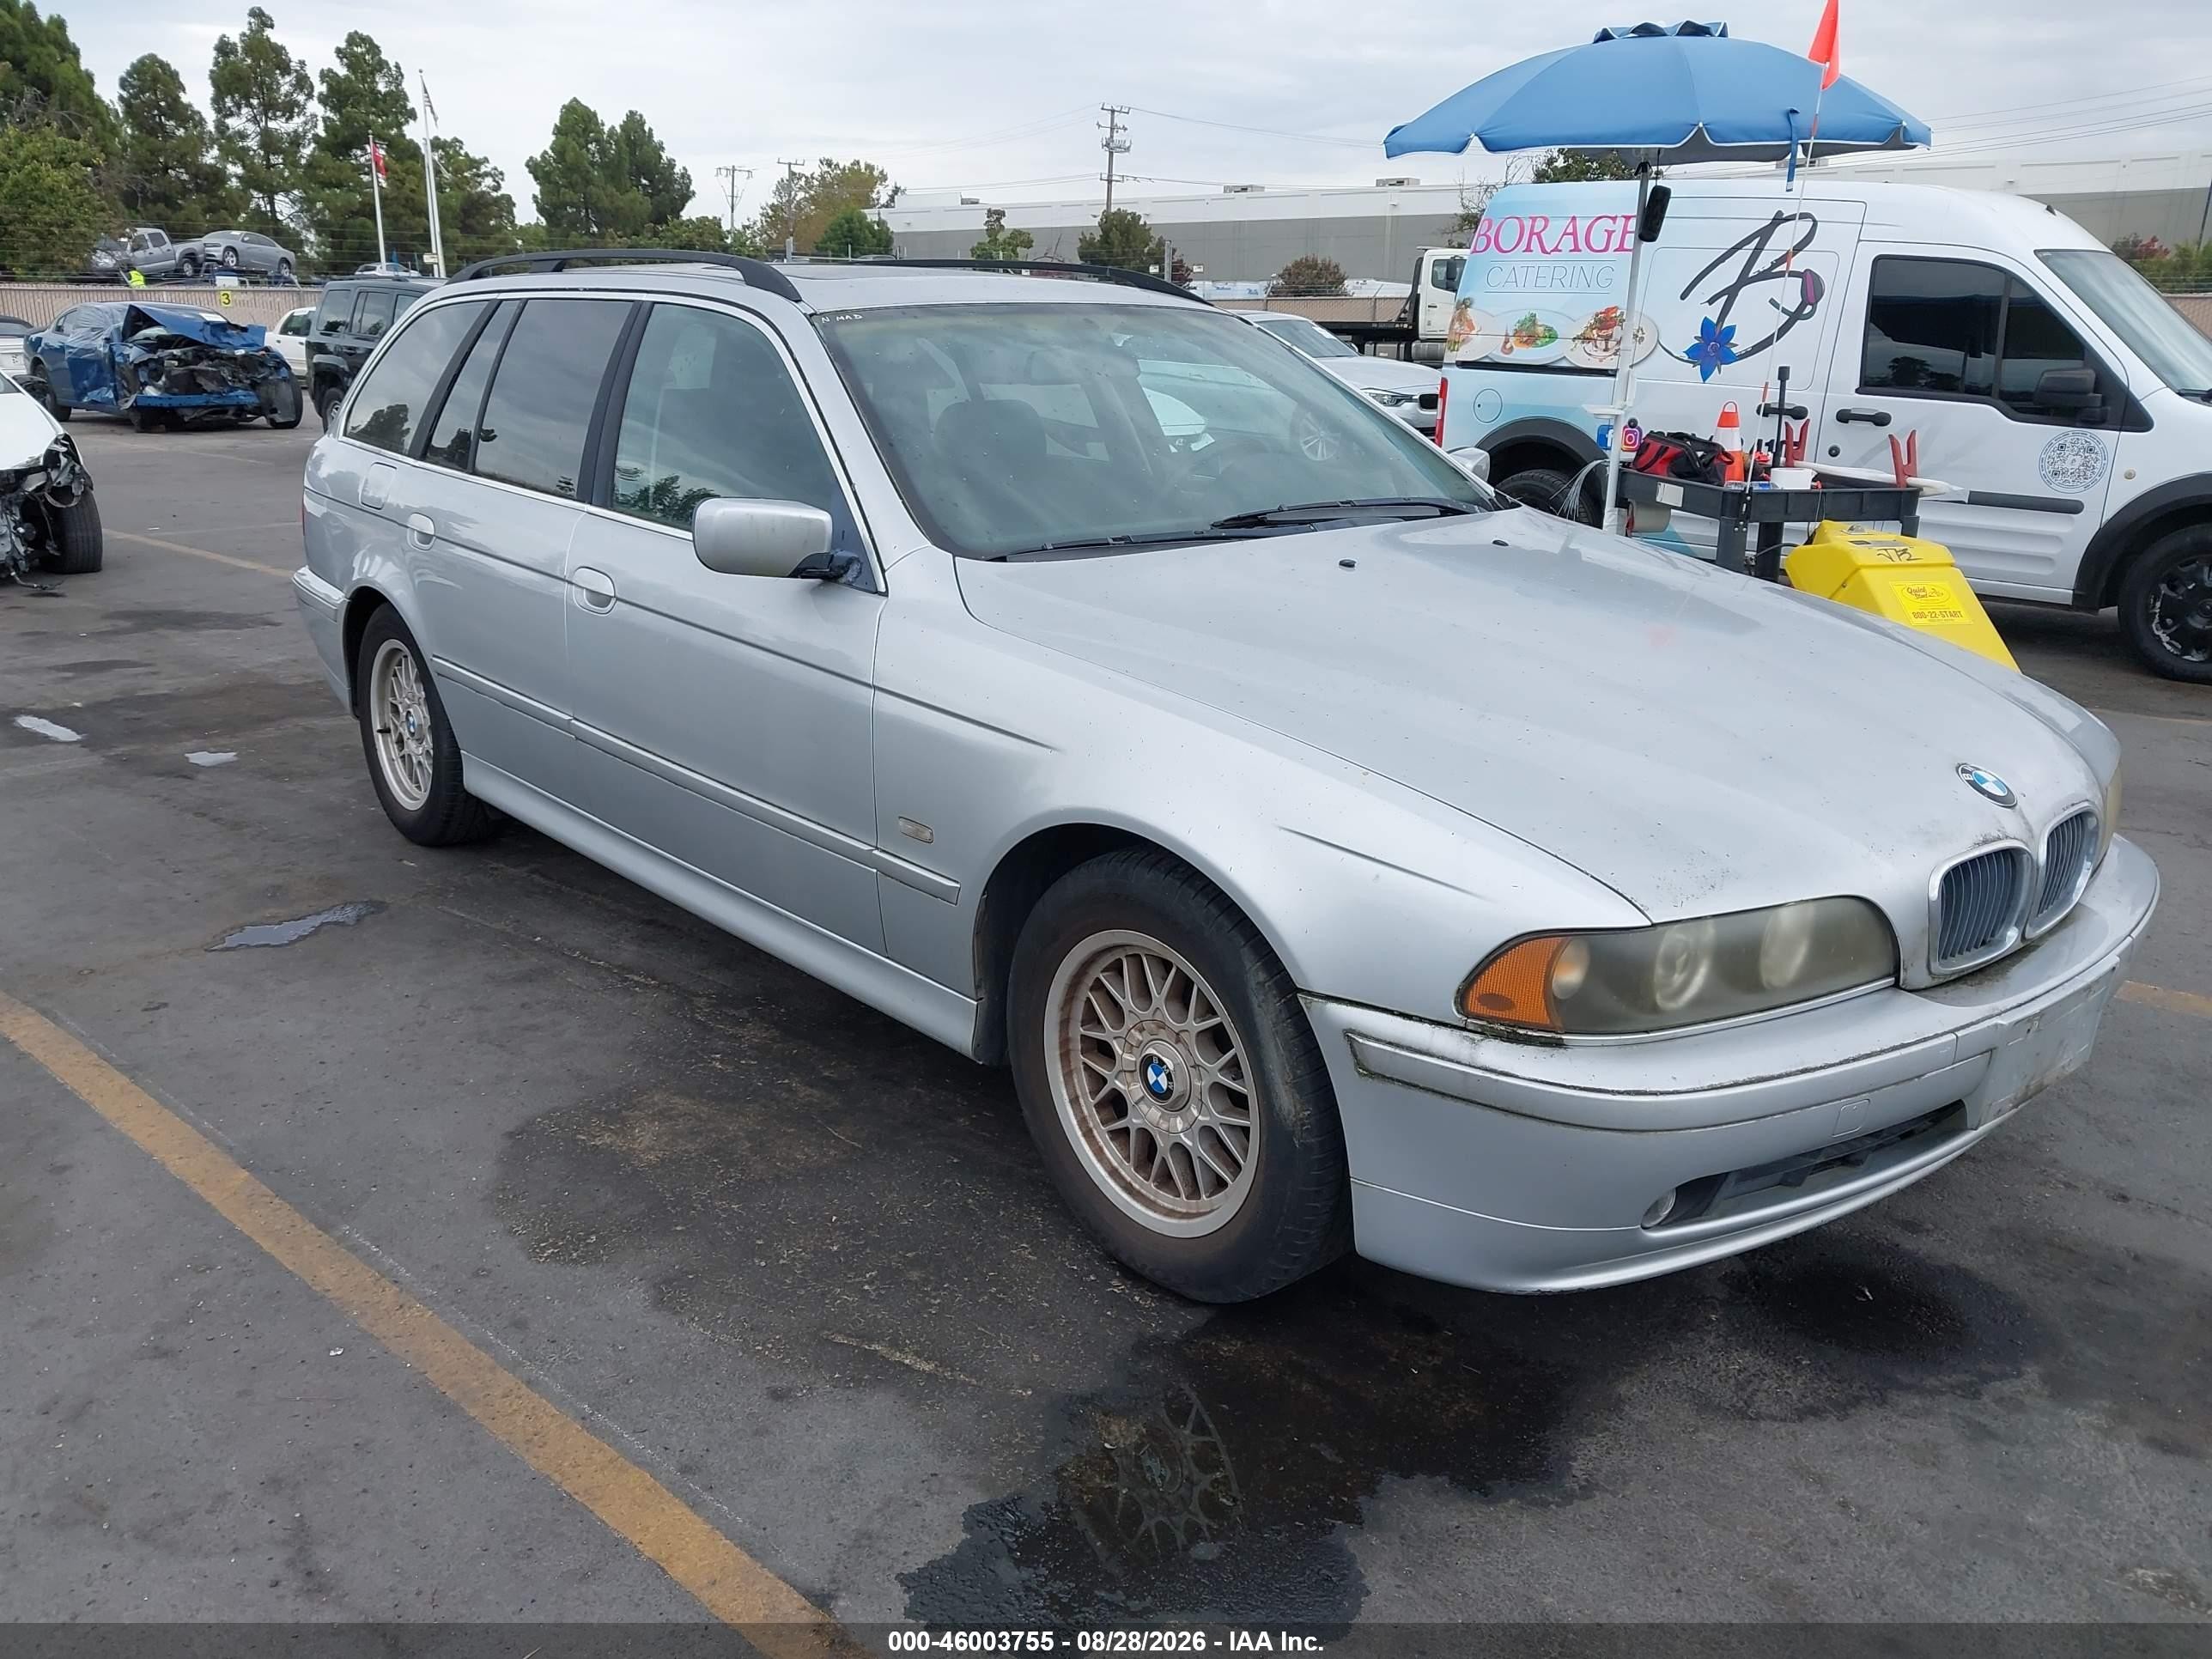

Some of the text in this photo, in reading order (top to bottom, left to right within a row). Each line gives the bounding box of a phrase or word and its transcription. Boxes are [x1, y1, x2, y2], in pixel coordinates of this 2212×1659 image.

[1486, 264, 1615, 289] CATERING
[222, 292, 231, 306] 3
[1911, 611, 1963, 619] 800-22-START
